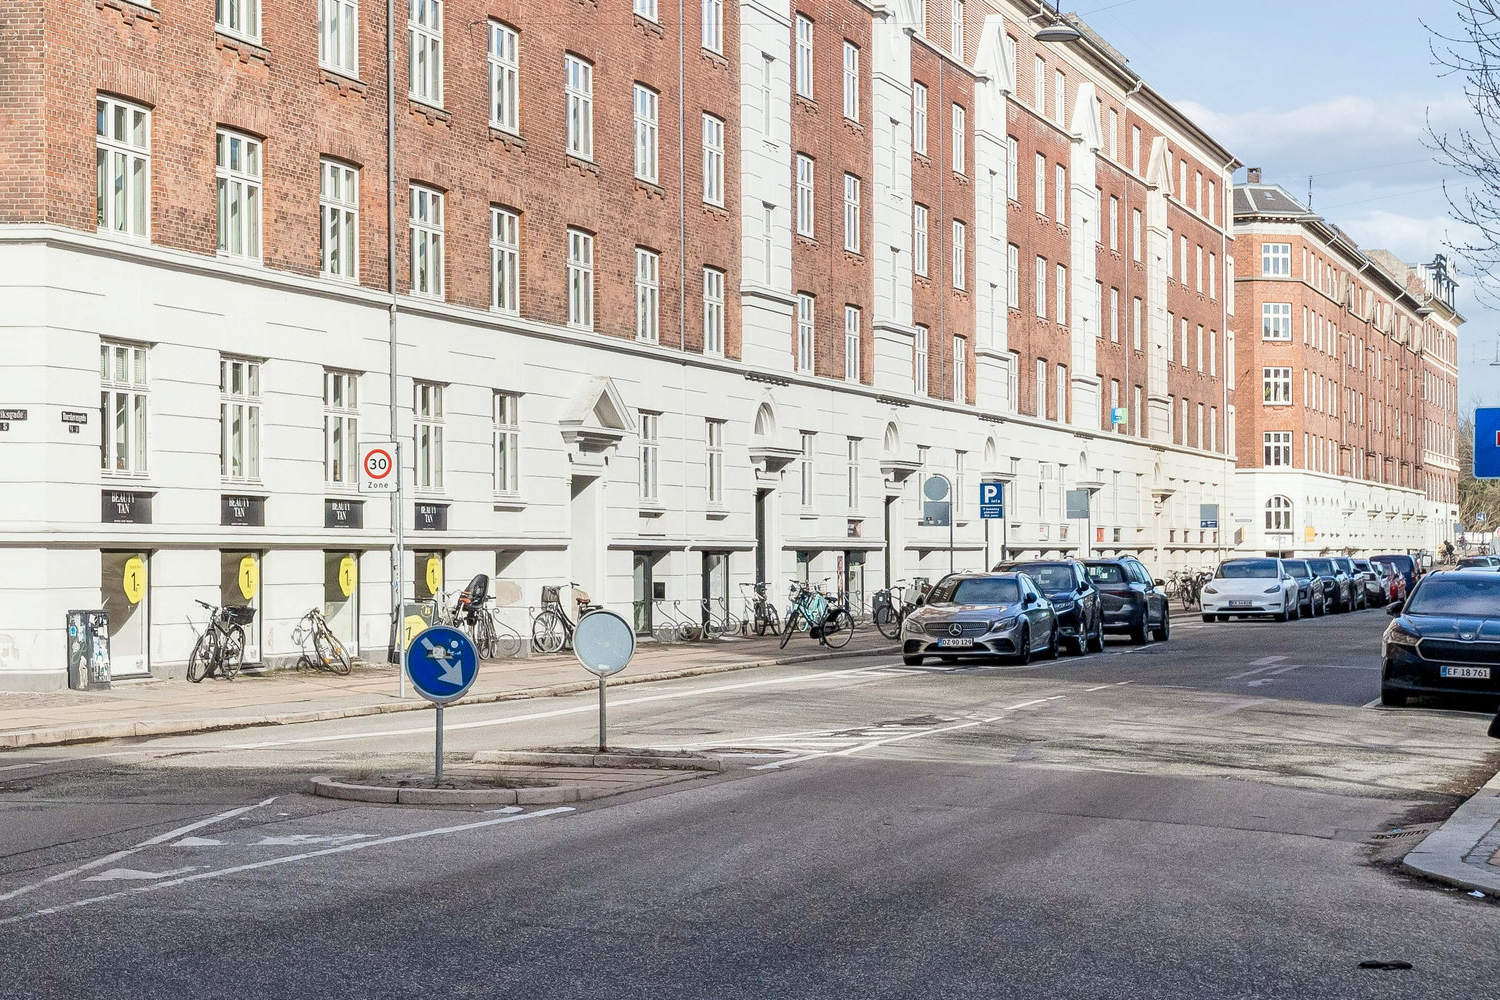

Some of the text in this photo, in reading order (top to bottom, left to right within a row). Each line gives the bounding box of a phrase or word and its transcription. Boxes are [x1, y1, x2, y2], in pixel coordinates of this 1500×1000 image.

[370, 458, 387, 470] 30
[367, 481, 388, 489] Zone
[111, 492, 135, 503] BEAUTY
[984, 485, 997, 503] P
[117, 502, 130, 514] TAN
[1473, 669, 1487, 677] 761
